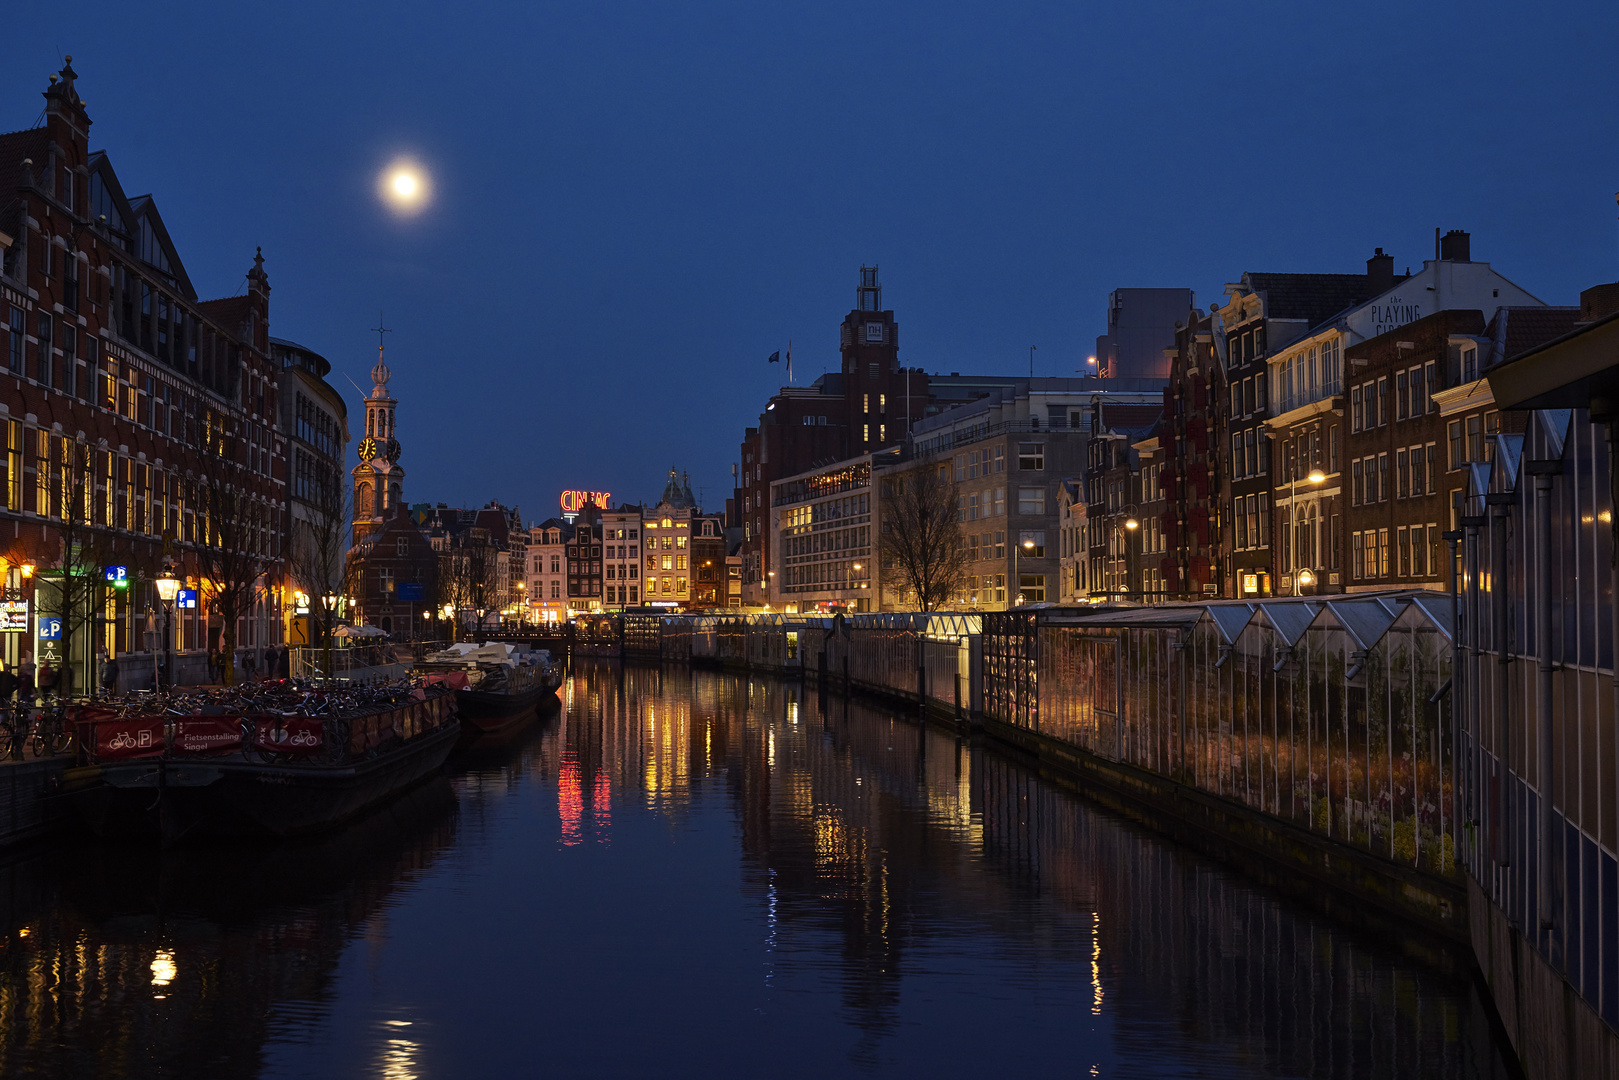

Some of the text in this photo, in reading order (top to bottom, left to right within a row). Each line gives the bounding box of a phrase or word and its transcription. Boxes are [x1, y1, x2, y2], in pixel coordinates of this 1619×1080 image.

[1371, 305, 1420, 323] PLAYING
[117, 569, 126, 580] P
[179, 592, 186, 602] P
[50, 622, 61, 637] P
[141, 731, 150, 746] P
[184, 732, 240, 742] Fietsenstalling
[184, 742, 208, 752] Singel
